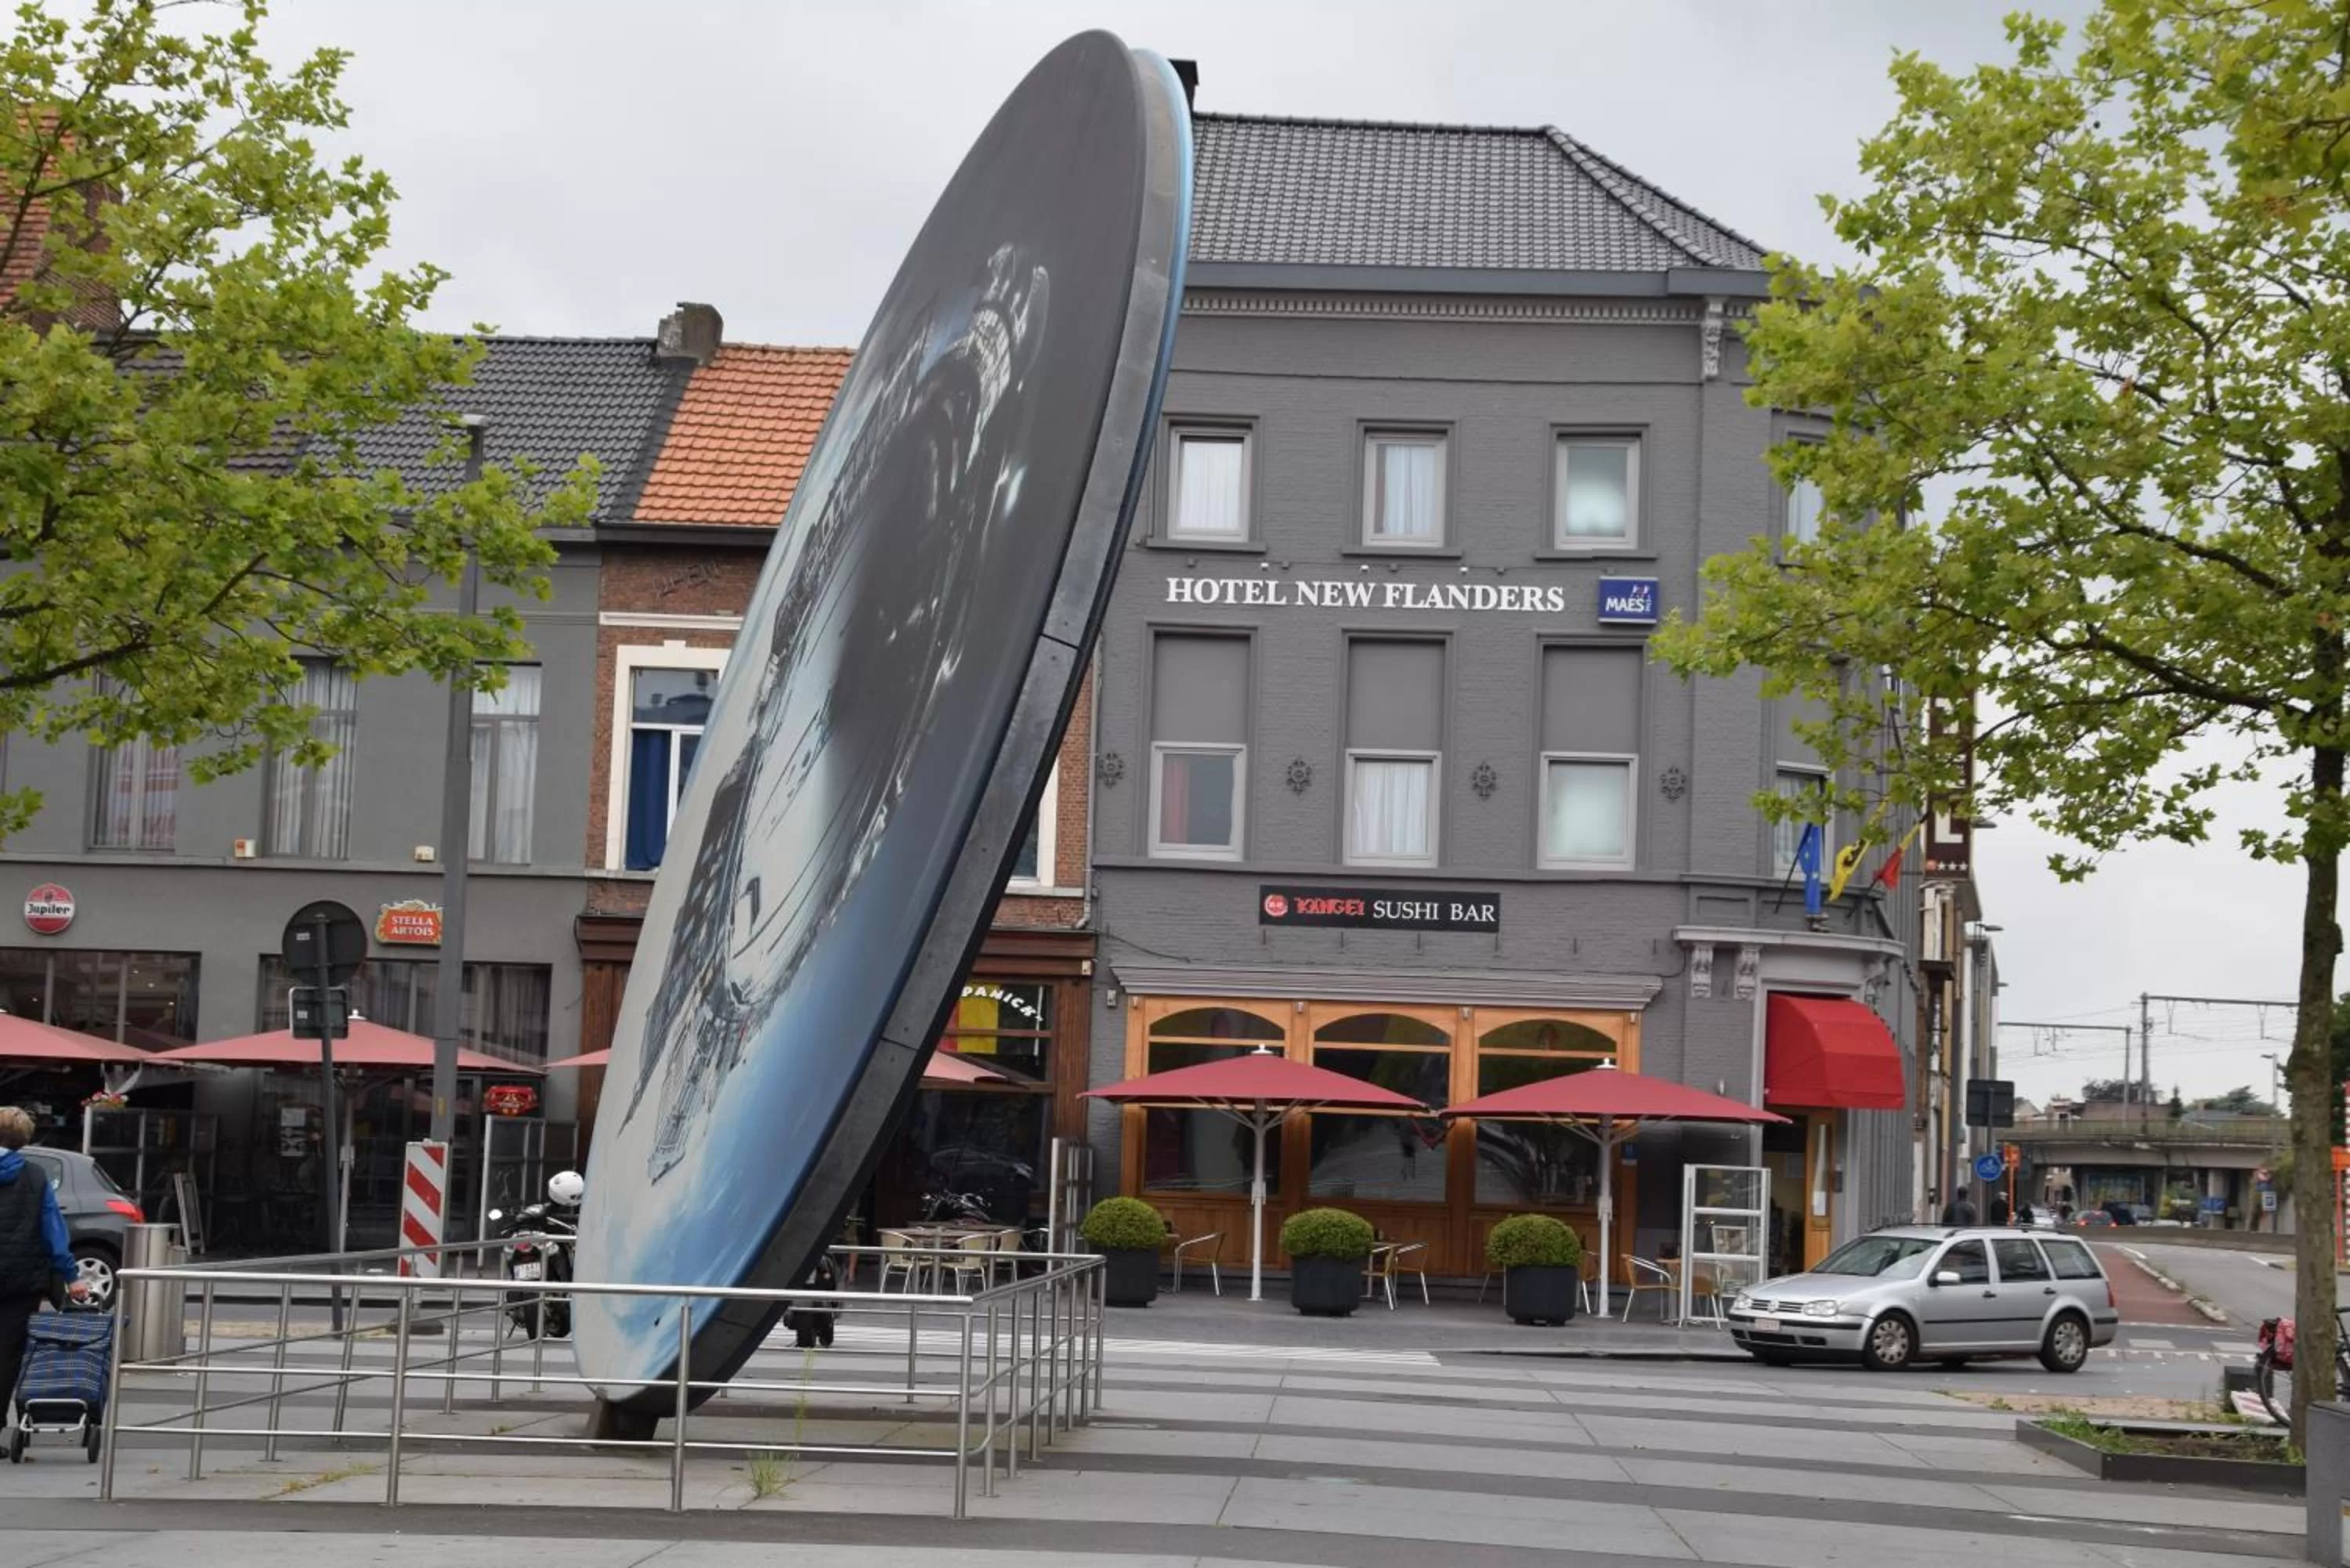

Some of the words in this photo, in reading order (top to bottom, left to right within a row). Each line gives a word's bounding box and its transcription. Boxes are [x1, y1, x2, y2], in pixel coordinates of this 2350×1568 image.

[1166, 577, 1286, 605] HOTEL
[1295, 581, 1376, 607] NEW
[1383, 583, 1564, 612] FLANDERS
[1605, 597, 1644, 612] MAES
[27, 903, 70, 916] Jupiler
[1372, 900, 1439, 919] SUSHI
[1450, 902, 1496, 922] BAR
[391, 916, 434, 926] STELLA
[391, 926, 434, 937] ARTOIS
